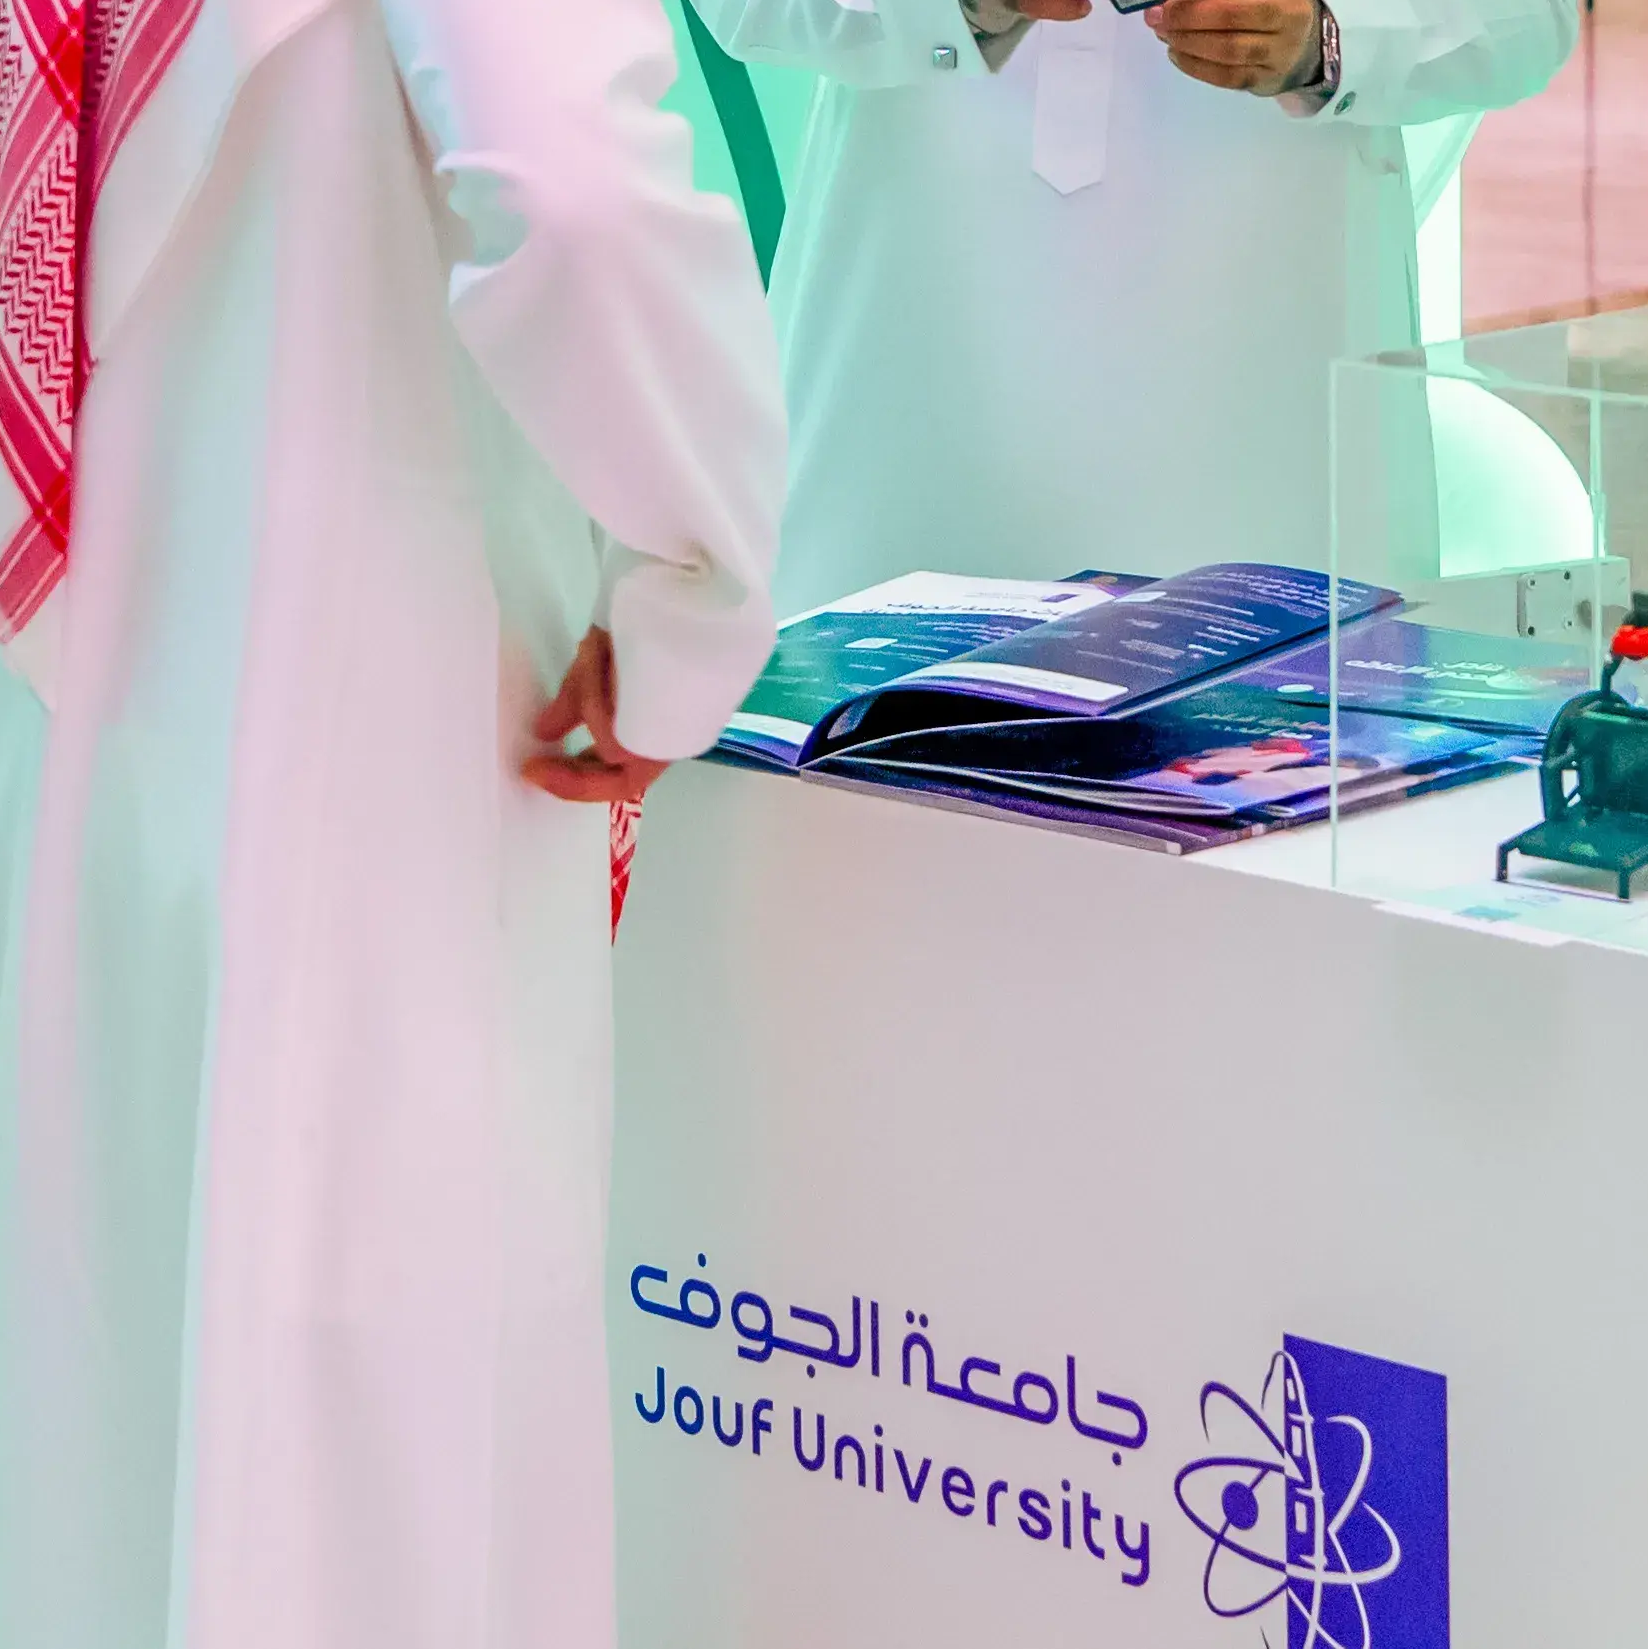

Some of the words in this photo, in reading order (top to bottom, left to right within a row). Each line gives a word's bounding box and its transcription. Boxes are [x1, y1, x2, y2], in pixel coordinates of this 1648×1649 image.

[630, 1253, 880, 1379] الجوف
[902, 1309, 1150, 1467] جامعة
[635, 1365, 774, 1457] Jouf
[792, 1403, 1151, 1588] University
